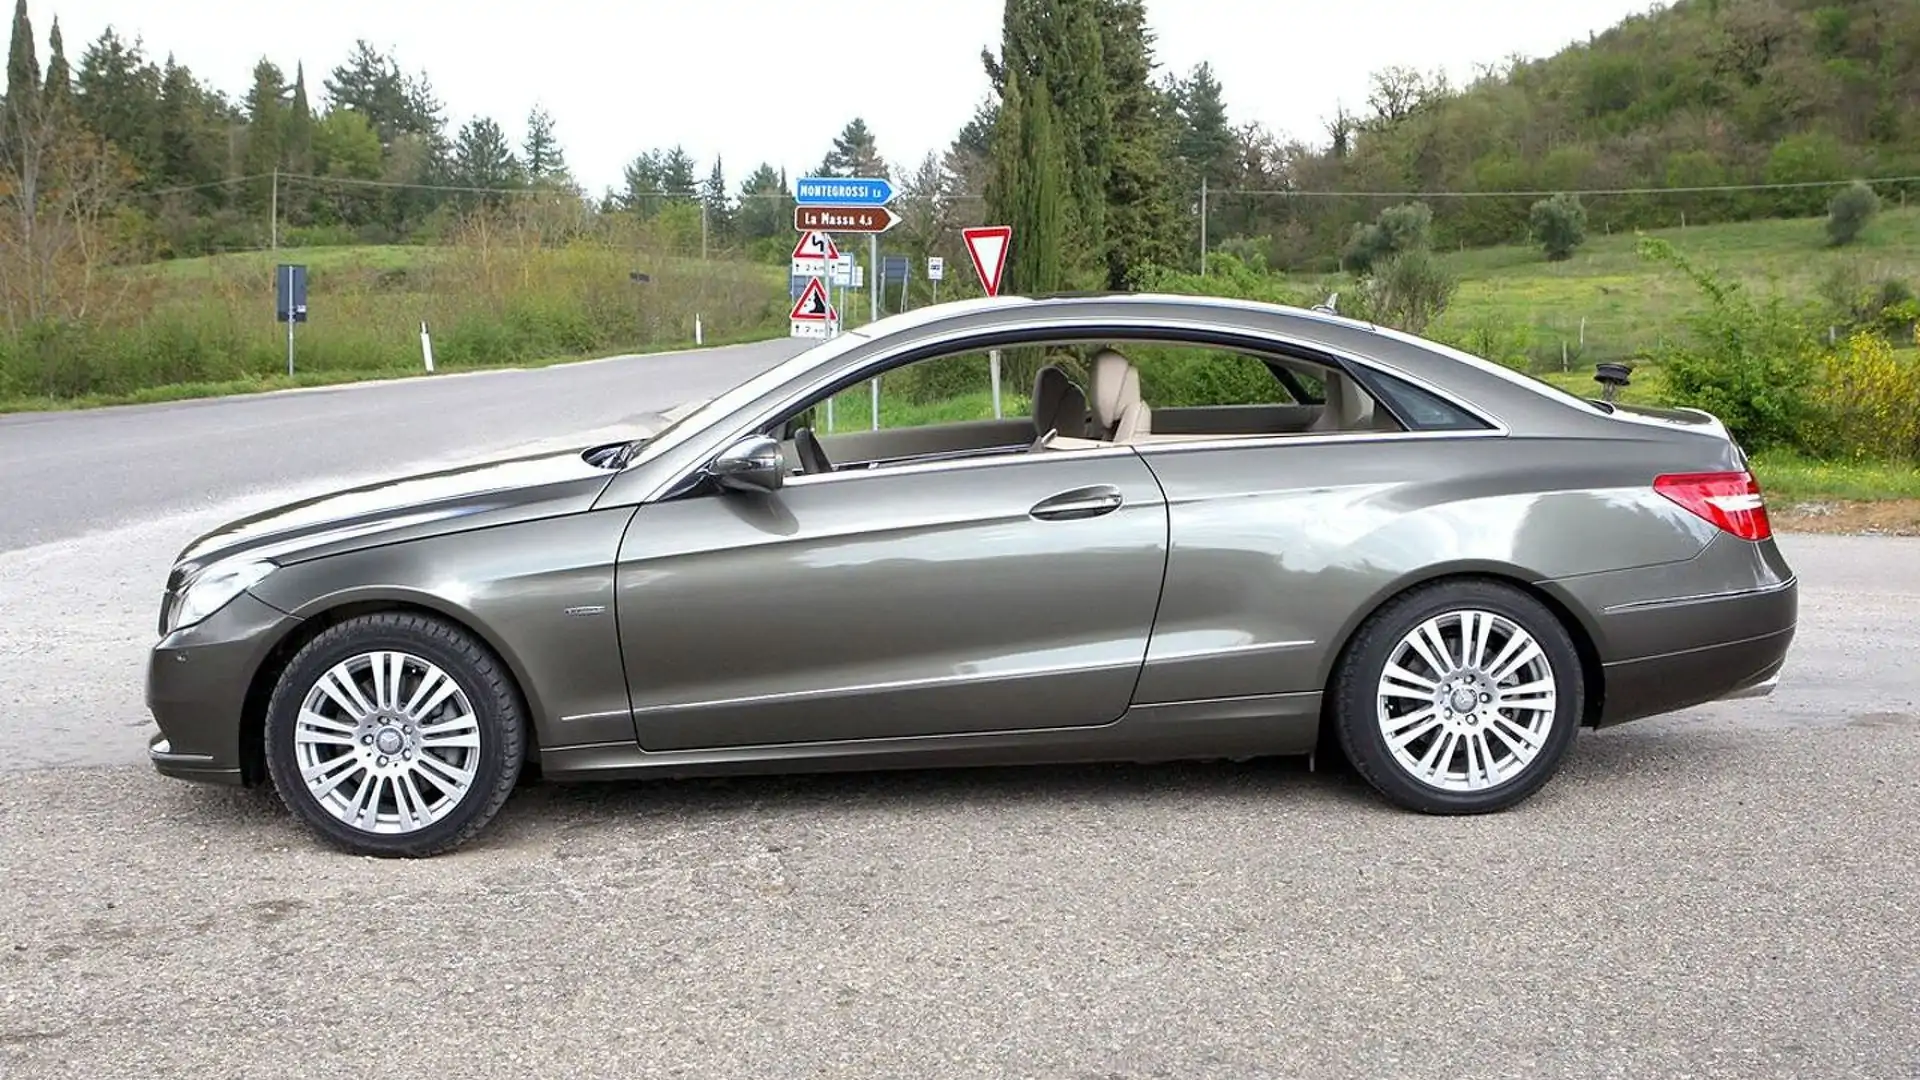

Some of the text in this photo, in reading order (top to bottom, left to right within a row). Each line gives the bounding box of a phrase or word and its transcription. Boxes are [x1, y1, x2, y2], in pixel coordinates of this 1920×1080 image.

[800, 185, 868, 198] MONTEGROSSI
[804, 212, 817, 225] La
[821, 212, 855, 226] Massa
